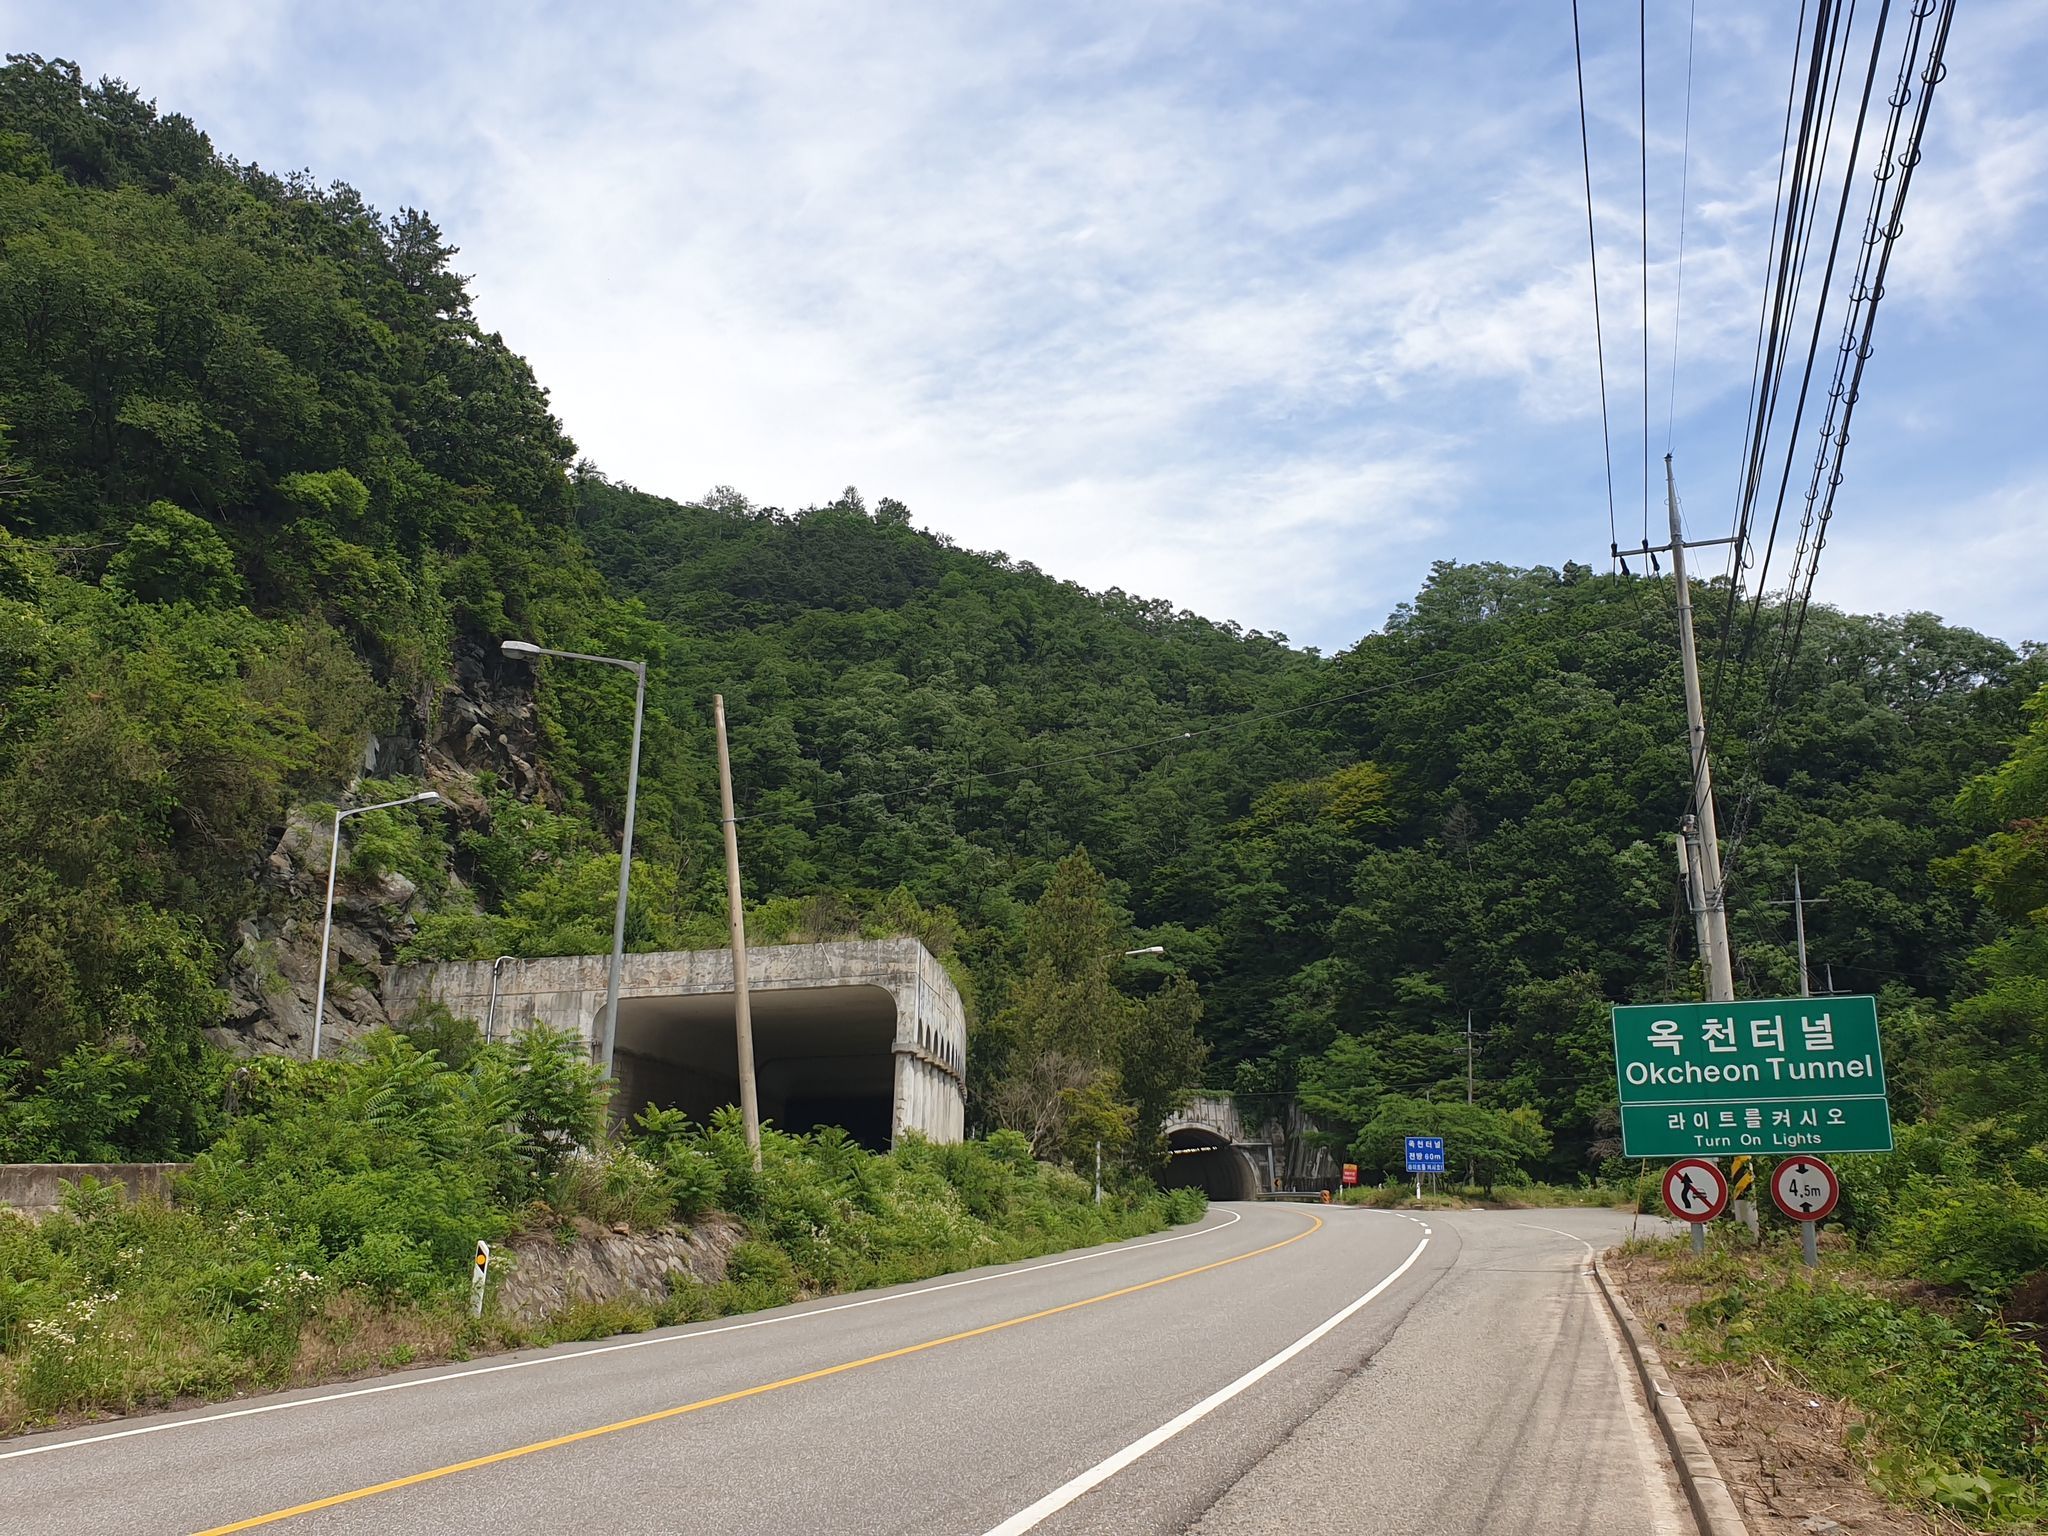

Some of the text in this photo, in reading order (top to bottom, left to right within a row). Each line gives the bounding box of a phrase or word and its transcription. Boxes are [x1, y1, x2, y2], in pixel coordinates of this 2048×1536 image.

[1647, 1013, 1835, 1055] 옥천터널
[1626, 1054, 1873, 1085] Okcheon Tunnel
[1694, 1133, 1821, 1148] Turn On Lights
[1788, 1178, 1821, 1198] 4.5m
